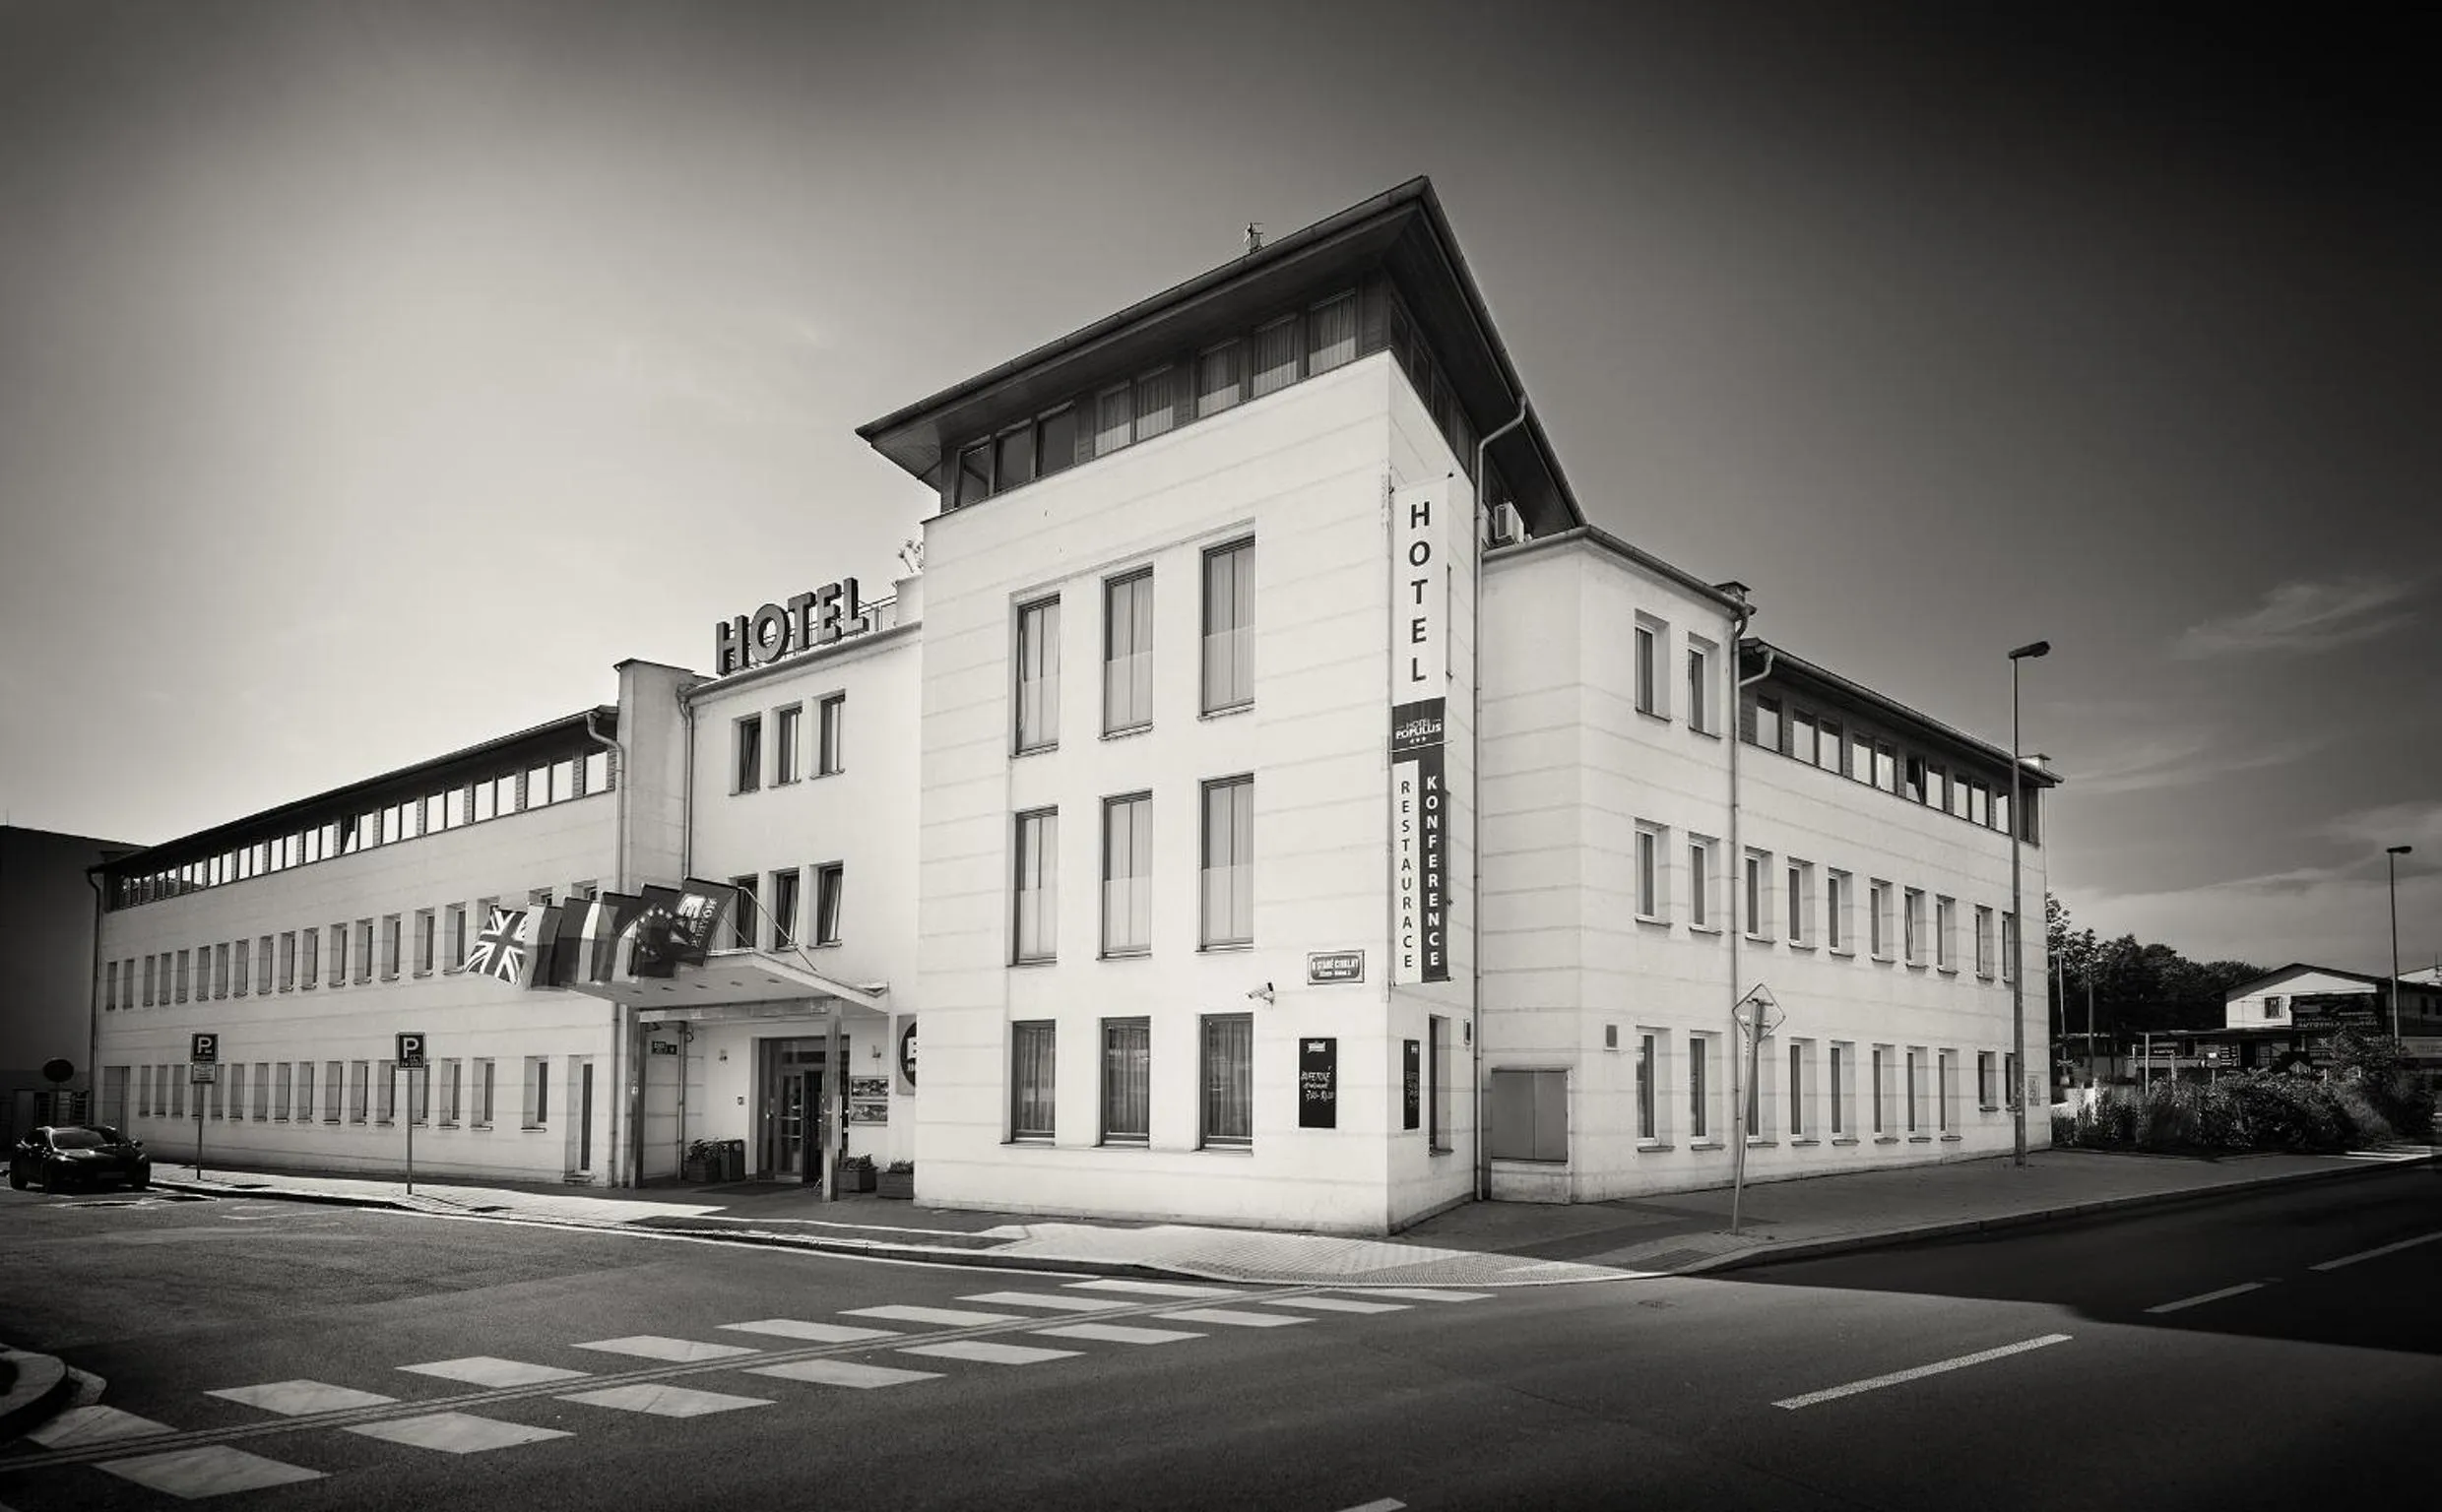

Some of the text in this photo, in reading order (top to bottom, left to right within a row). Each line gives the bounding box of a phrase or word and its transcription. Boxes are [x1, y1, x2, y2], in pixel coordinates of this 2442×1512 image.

[716, 577, 869, 676] HOTEL
[1408, 500, 1432, 683] HOTEL
[1395, 723, 1442, 740] POPULUS
[1399, 780, 1413, 969] RESTAURACE
[1425, 775, 1441, 967] KONFERENCE
[197, 1036, 213, 1054] P
[403, 1038, 419, 1059] P
